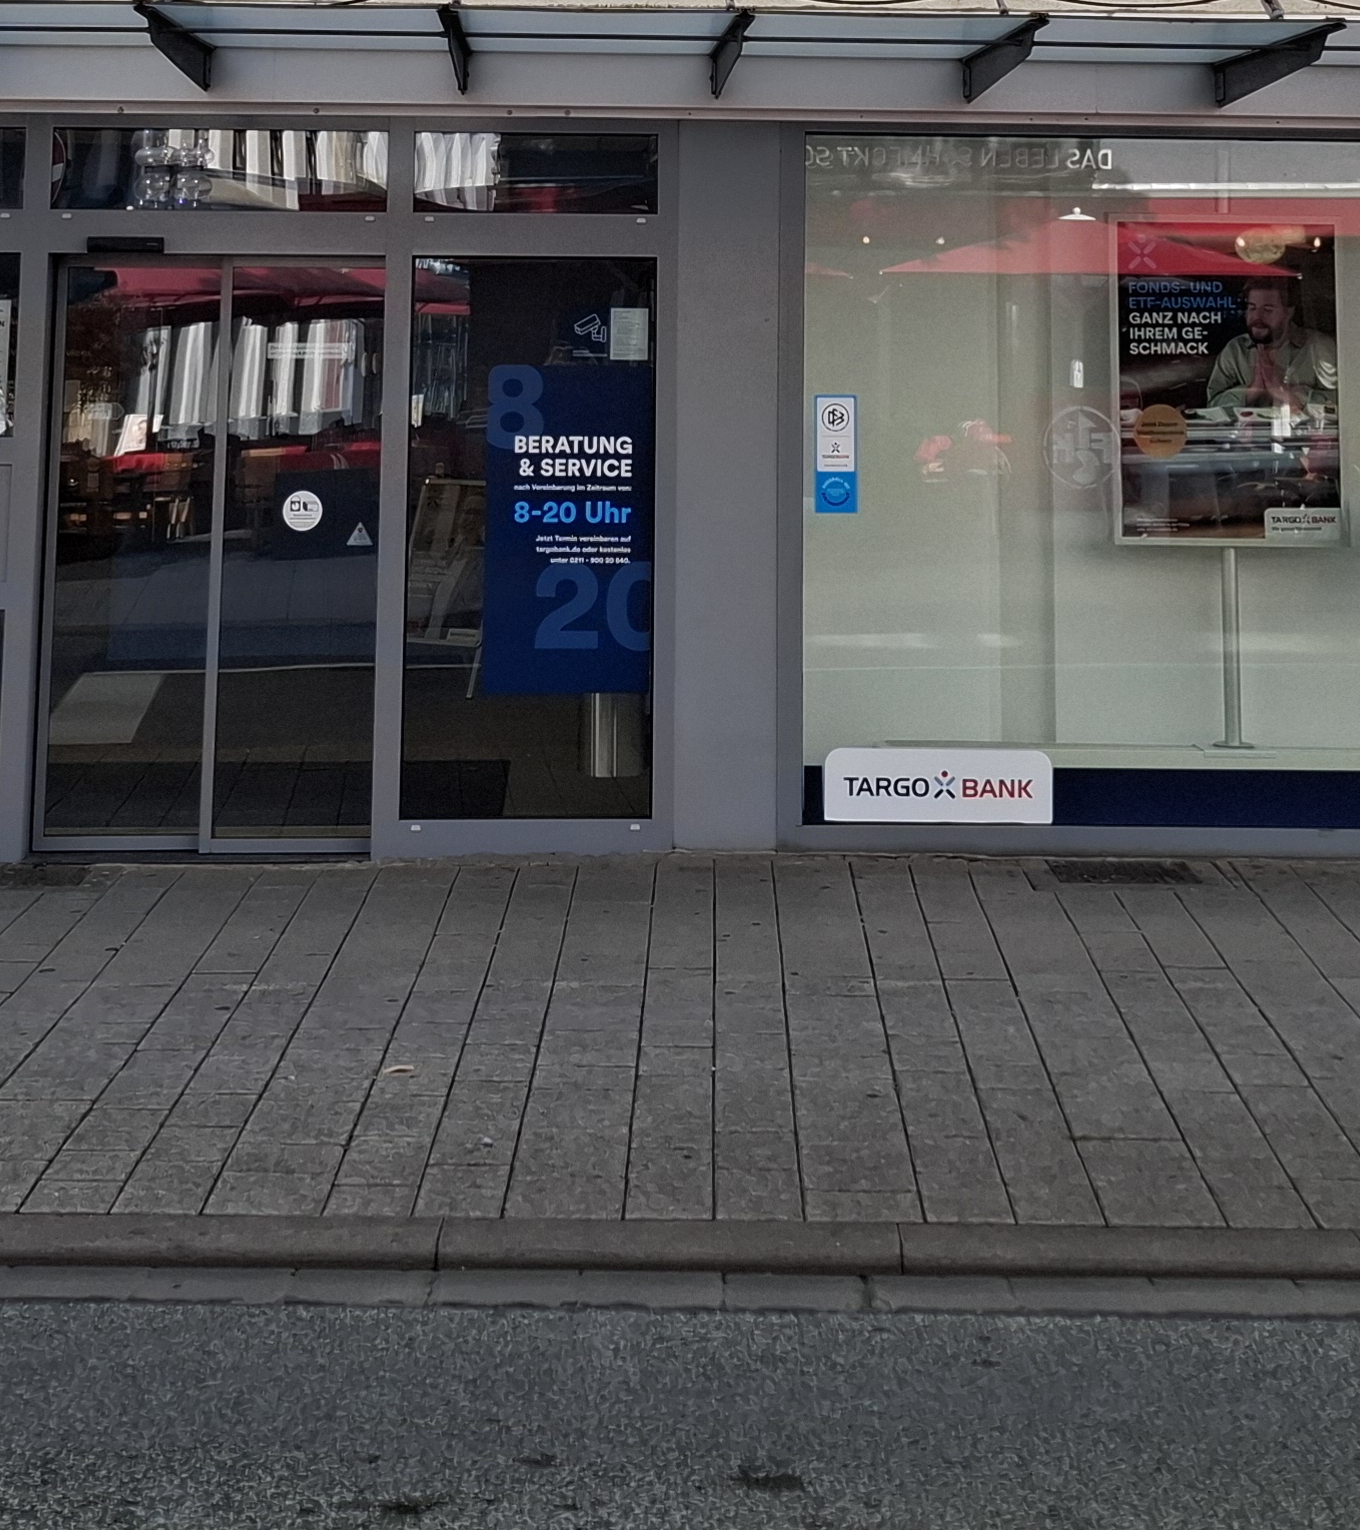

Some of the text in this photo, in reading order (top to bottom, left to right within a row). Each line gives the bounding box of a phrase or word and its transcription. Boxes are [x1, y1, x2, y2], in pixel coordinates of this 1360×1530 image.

[1128, 281, 1223, 294] FONDS- UND
[1128, 296, 1237, 309] ETF-AUSWAHL
[1128, 311, 1222, 325] GANZ NACH
[1129, 327, 1209, 340] IHREM GE-
[1129, 342, 1209, 355] SCHMACK
[513, 435, 633, 455] BERATUNG
[518, 458, 633, 478] & SERVICE
[513, 500, 632, 523] 8-20 Uhr
[843, 776, 1033, 799] TARGO BANK
